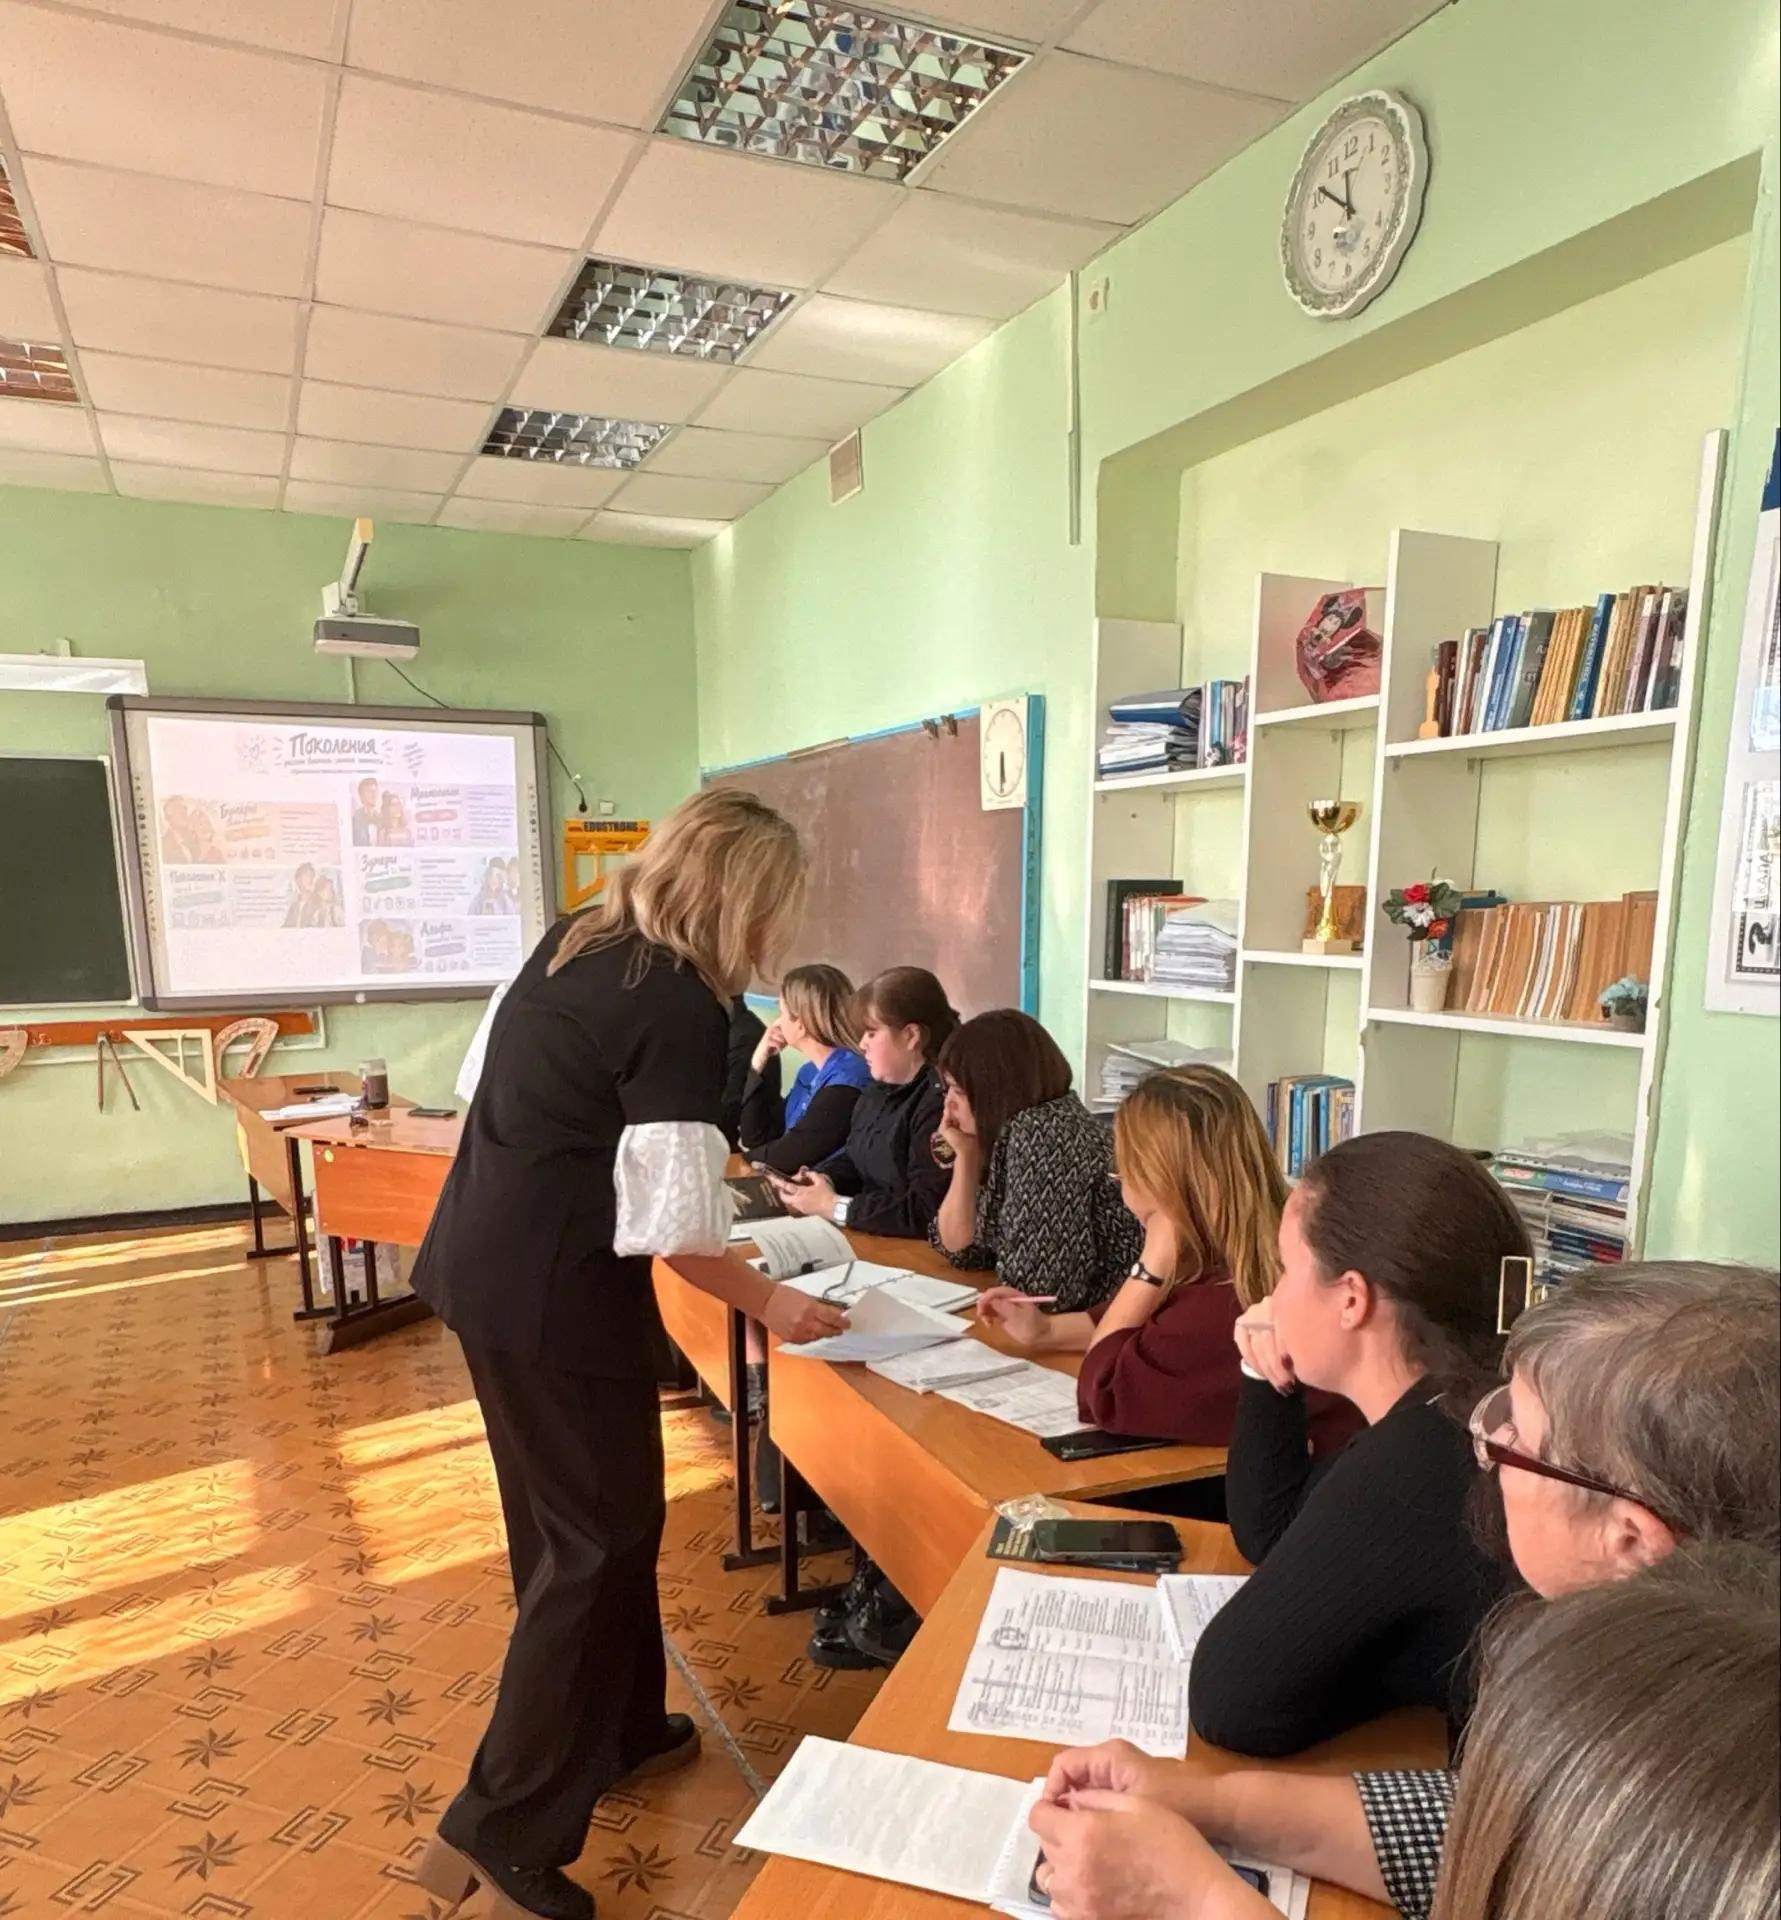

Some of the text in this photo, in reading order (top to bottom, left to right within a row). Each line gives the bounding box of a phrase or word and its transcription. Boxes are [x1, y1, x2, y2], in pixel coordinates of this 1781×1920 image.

[1344, 135, 1359, 161] 12
[1367, 132, 1375, 154] 1
[1381, 144, 1390, 166] 2
[1328, 156, 1339, 179] 11
[1384, 172, 1392, 194] 3
[1312, 189, 1326, 209] 10
[1307, 221, 1316, 240] 9
[1361, 238, 1370, 257] 5
[1314, 248, 1322, 269] 8
[1328, 260, 1336, 279] 7
[1344, 263, 1353, 277] 6
[289, 732, 378, 757] Поколения
